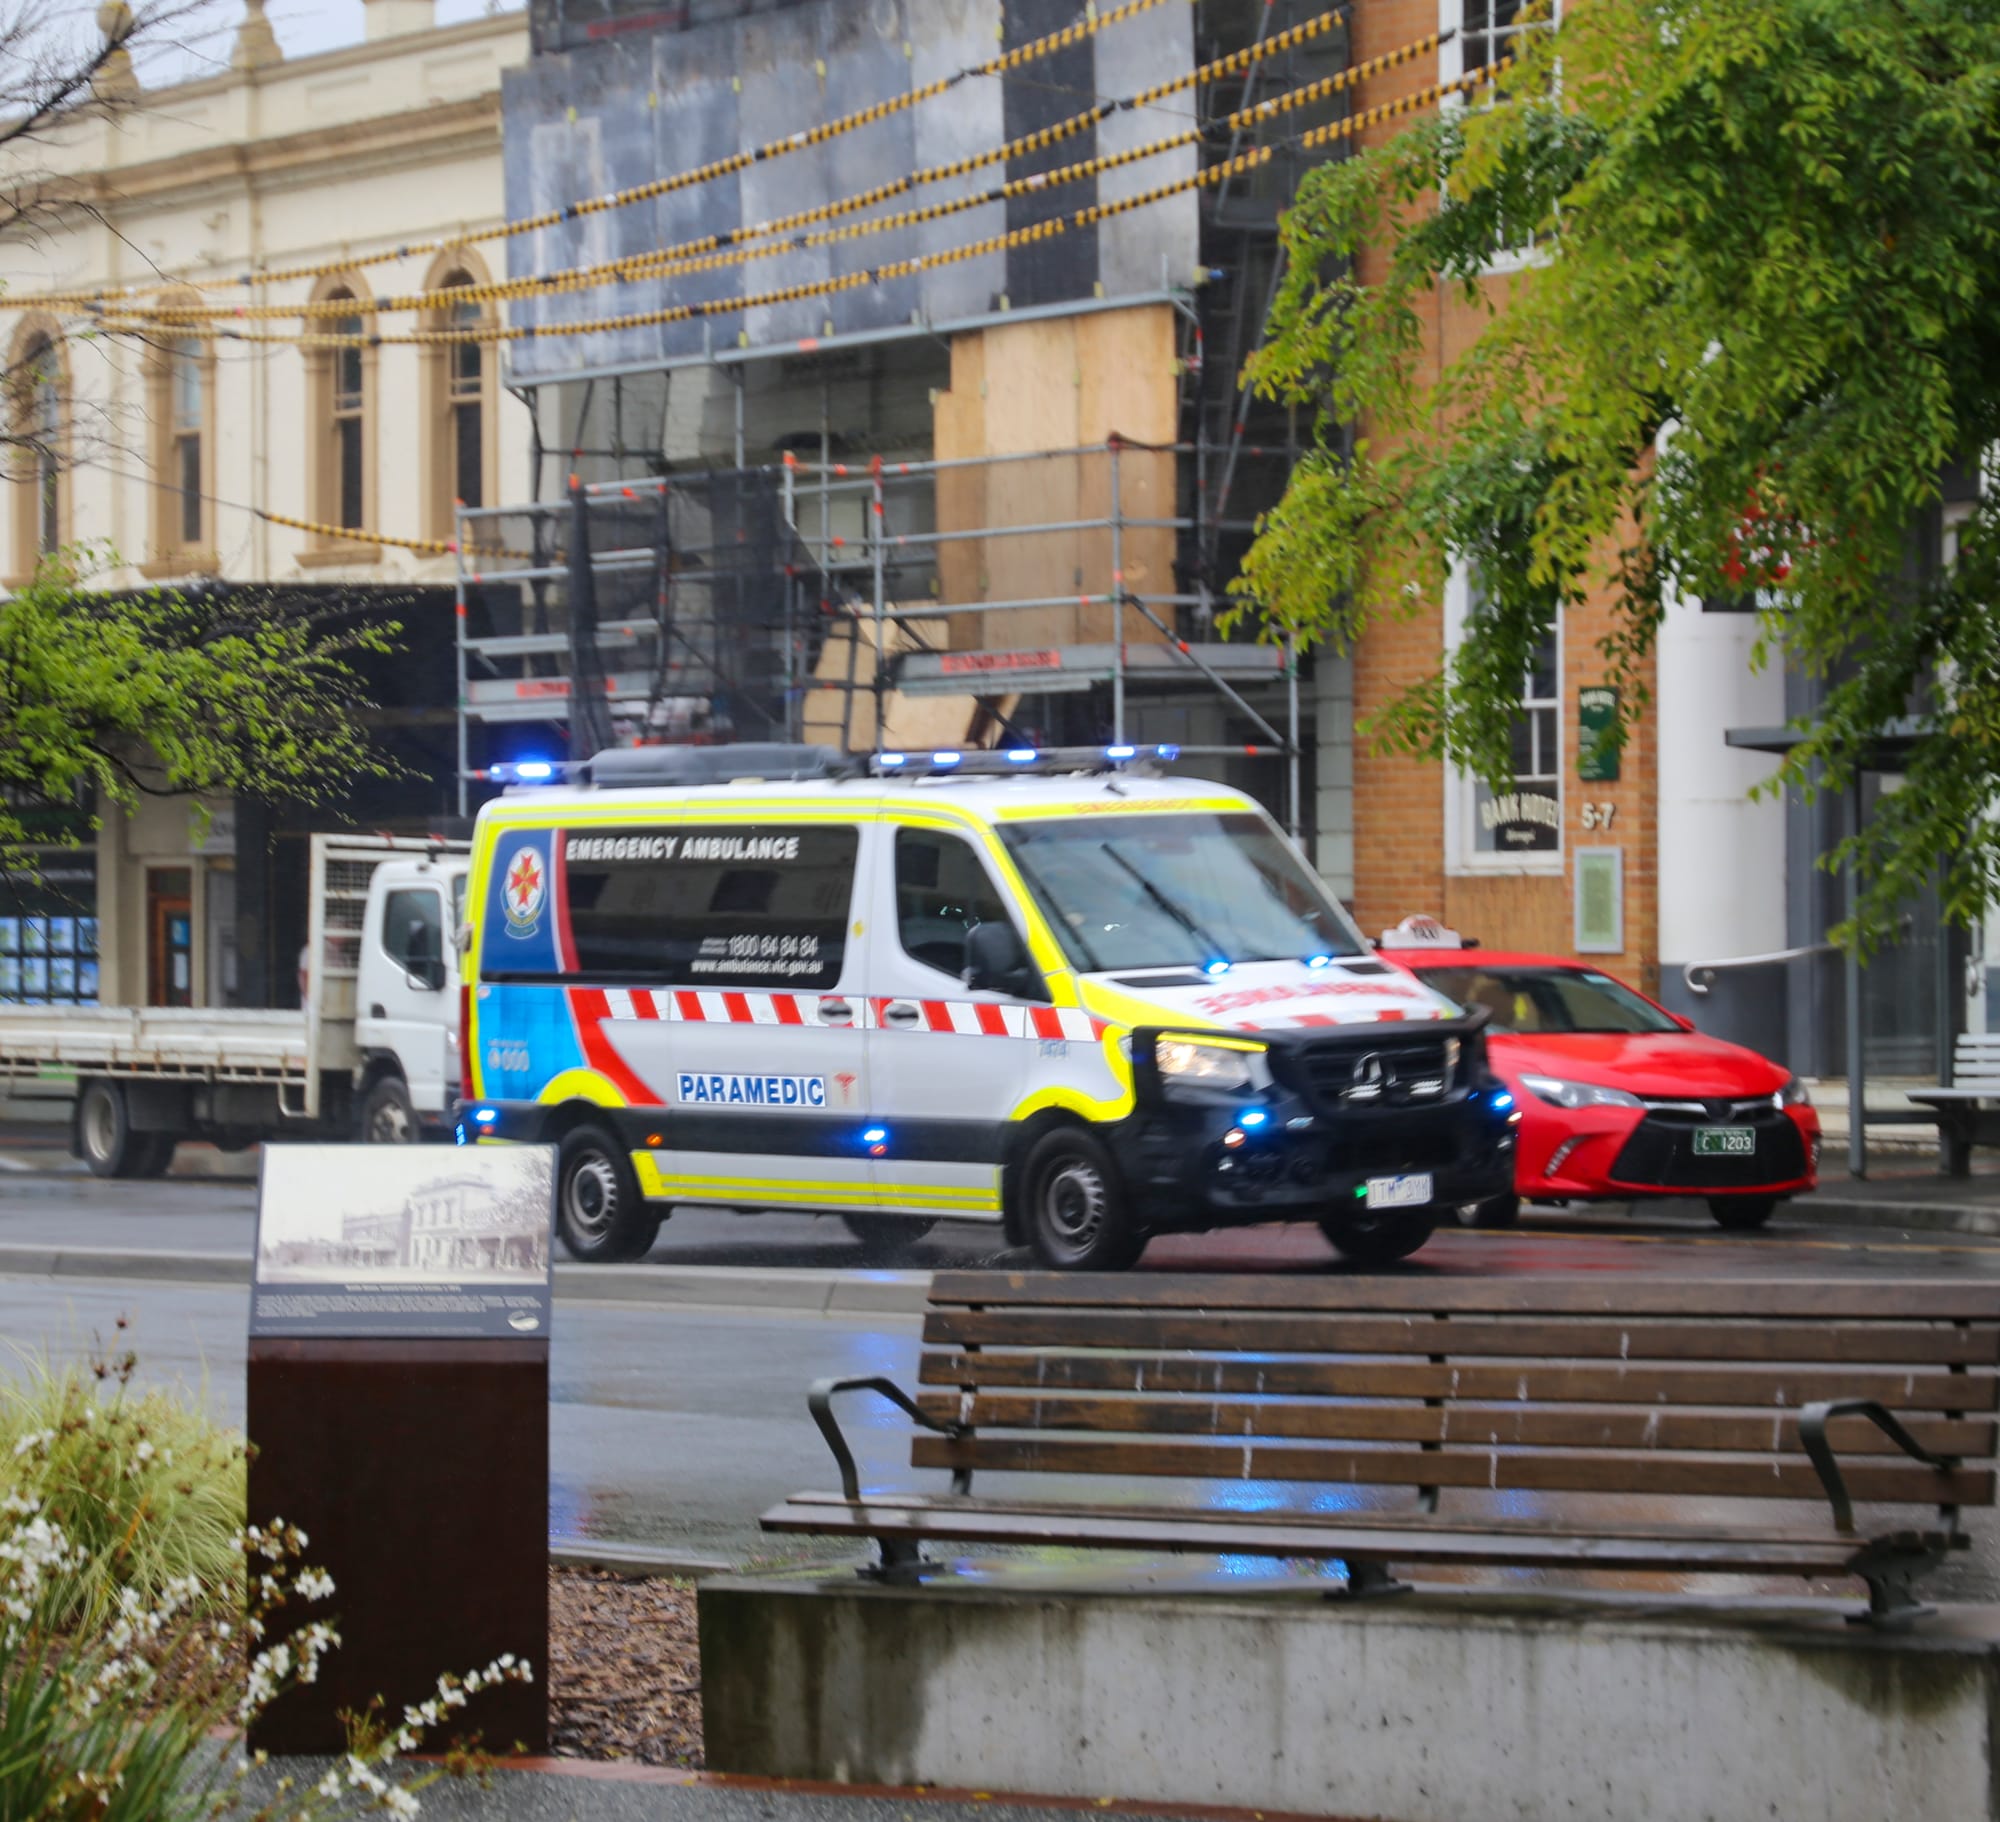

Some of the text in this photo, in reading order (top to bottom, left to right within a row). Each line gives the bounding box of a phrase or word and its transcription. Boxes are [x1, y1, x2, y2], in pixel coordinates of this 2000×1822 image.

[1582, 802, 1615, 830] 5-7
[565, 836, 800, 861] EMERGENCY AMBULANCE
[728, 935, 760, 956] 1800
[780, 935, 799, 957] 84
[799, 935, 818, 958] 84
[679, 1075, 824, 1105] PARAMEDIC
[1723, 1136, 1752, 1150] 1203
